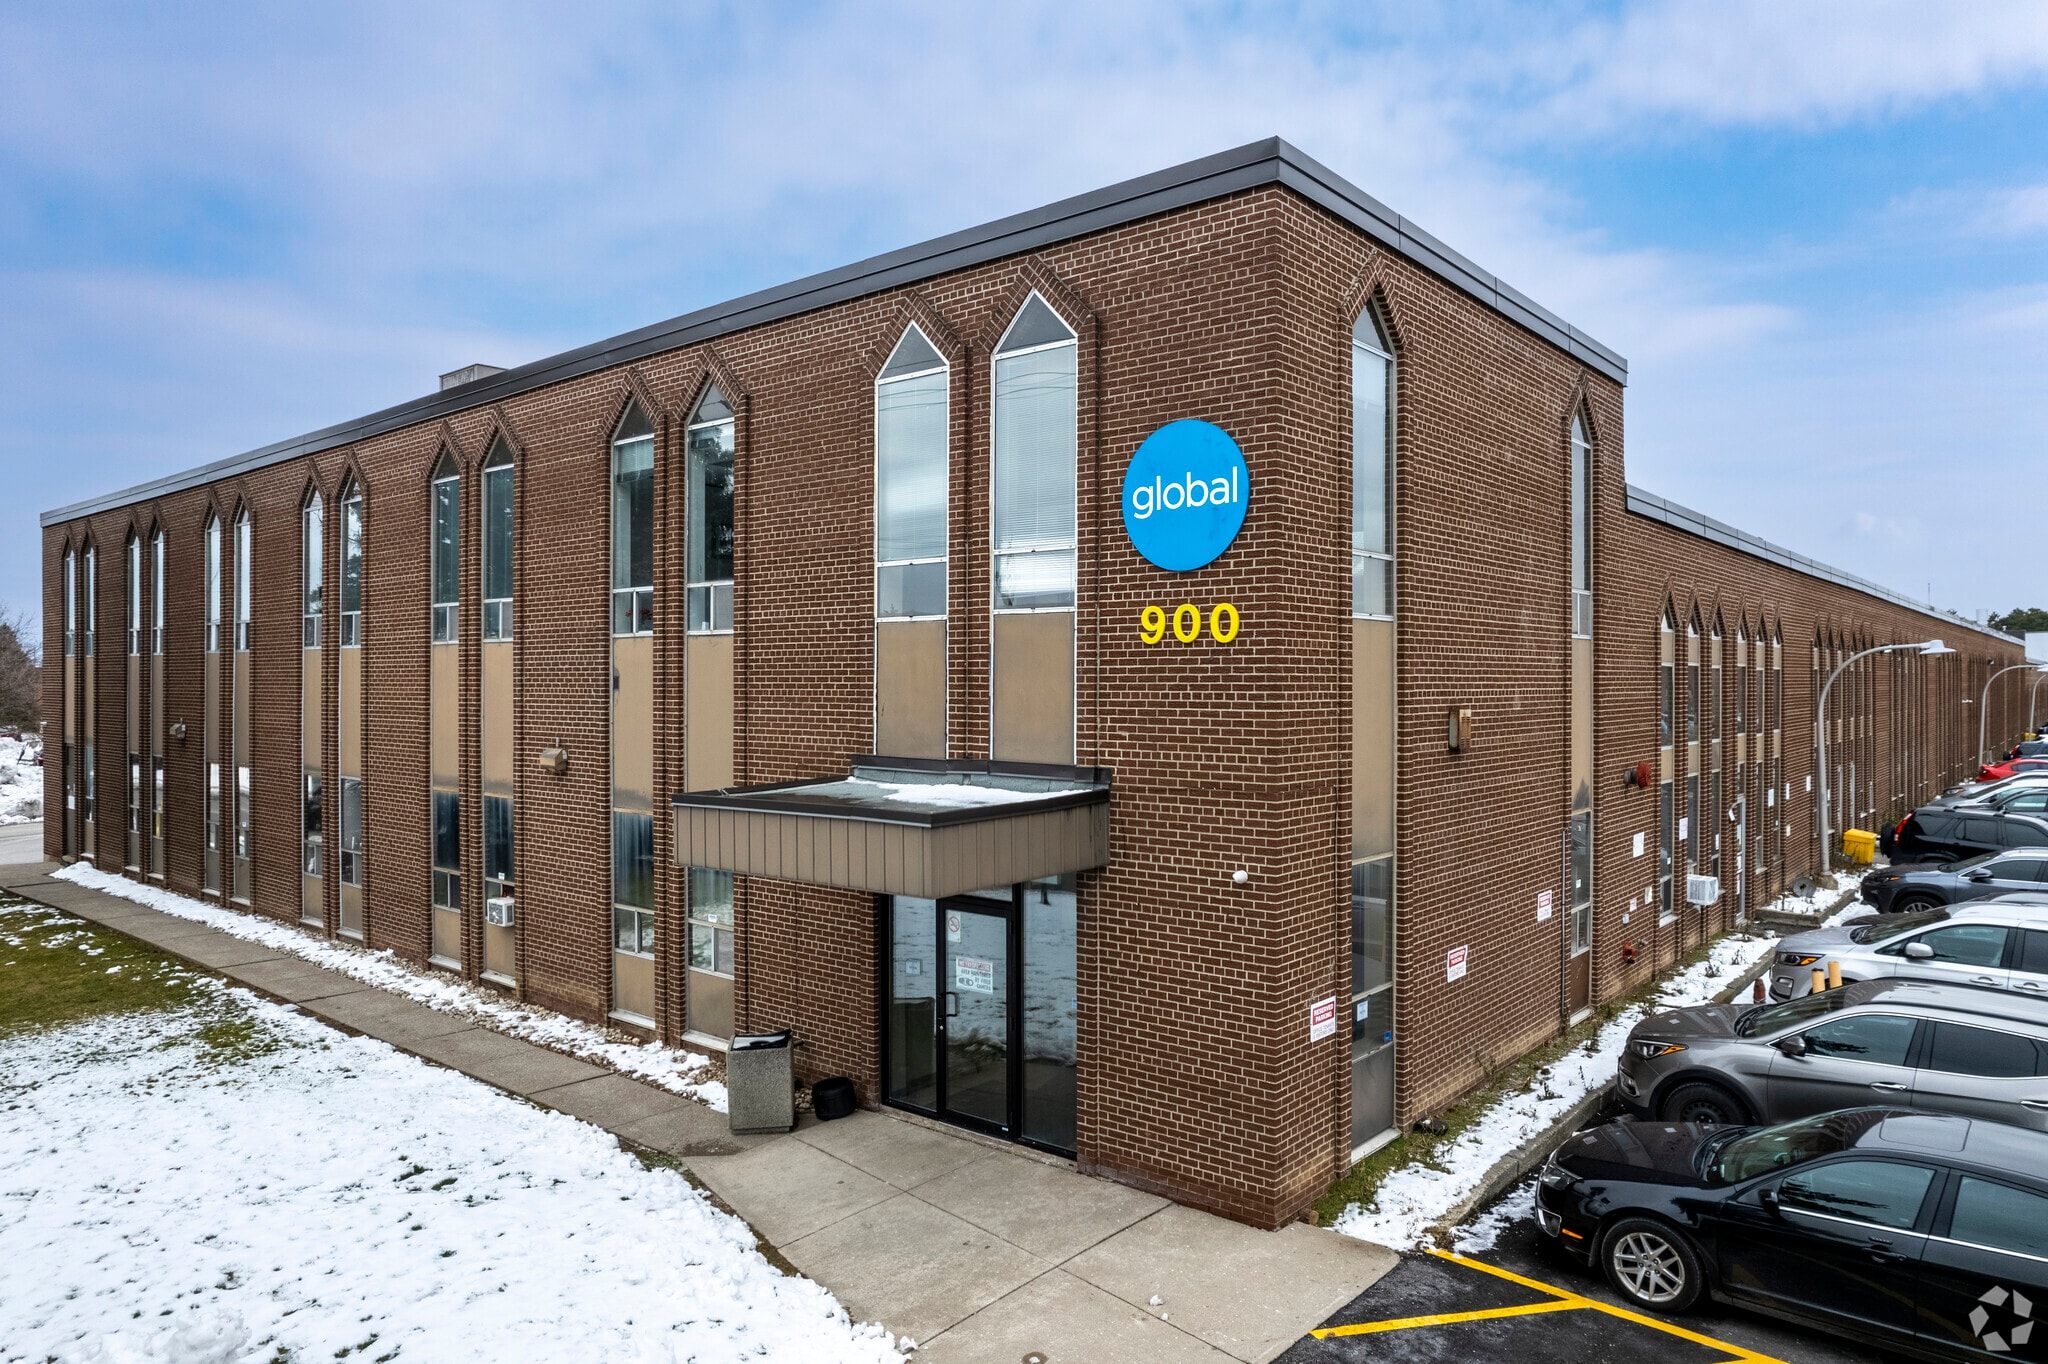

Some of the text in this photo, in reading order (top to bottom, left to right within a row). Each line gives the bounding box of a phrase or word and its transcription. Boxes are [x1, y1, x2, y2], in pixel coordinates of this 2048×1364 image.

[1132, 466, 1238, 520] global
[1140, 602, 1240, 645] 900
[1313, 1004, 1333, 1017] RESERVED
[1315, 1010, 1332, 1023] PARKING
